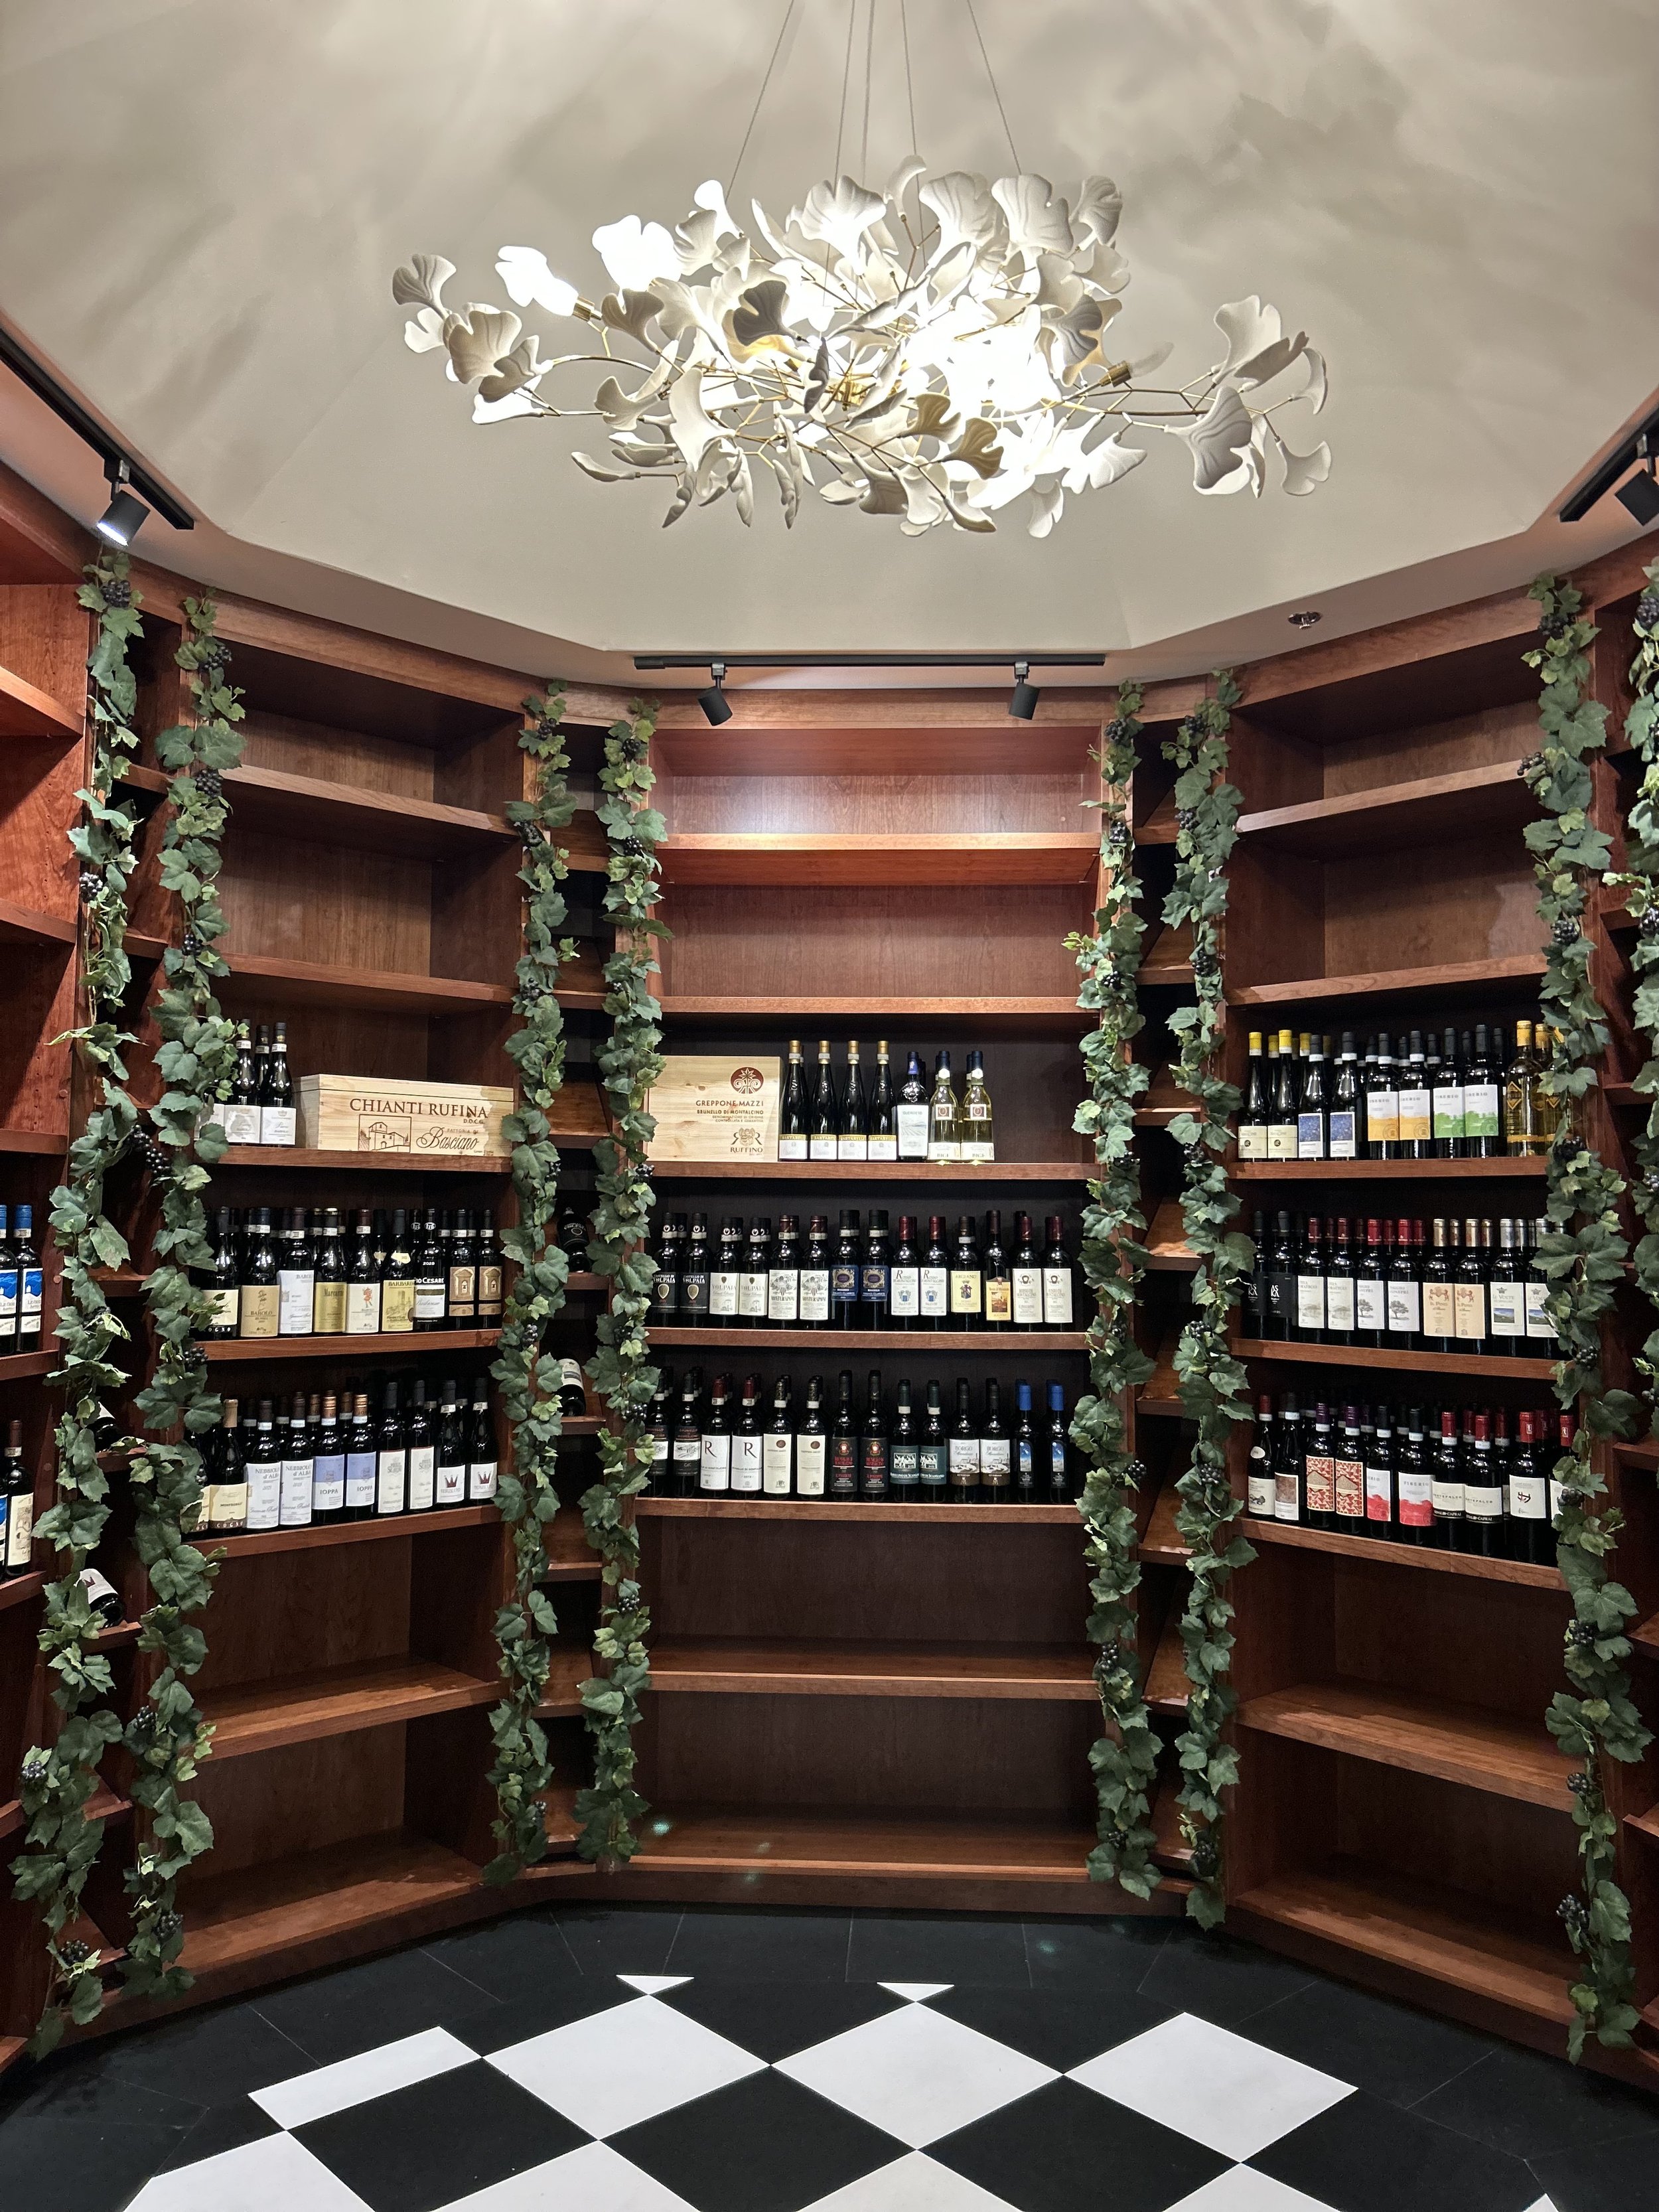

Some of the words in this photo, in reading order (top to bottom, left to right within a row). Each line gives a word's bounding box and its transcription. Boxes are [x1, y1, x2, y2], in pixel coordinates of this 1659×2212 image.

[350, 1098, 423, 1114] CHIANTI
[428, 1103, 488, 1118] RUFINA
[416, 1126, 479, 1150] Basciano
[704, 1440, 717, 1458] R
[743, 1441, 758, 1459] R
